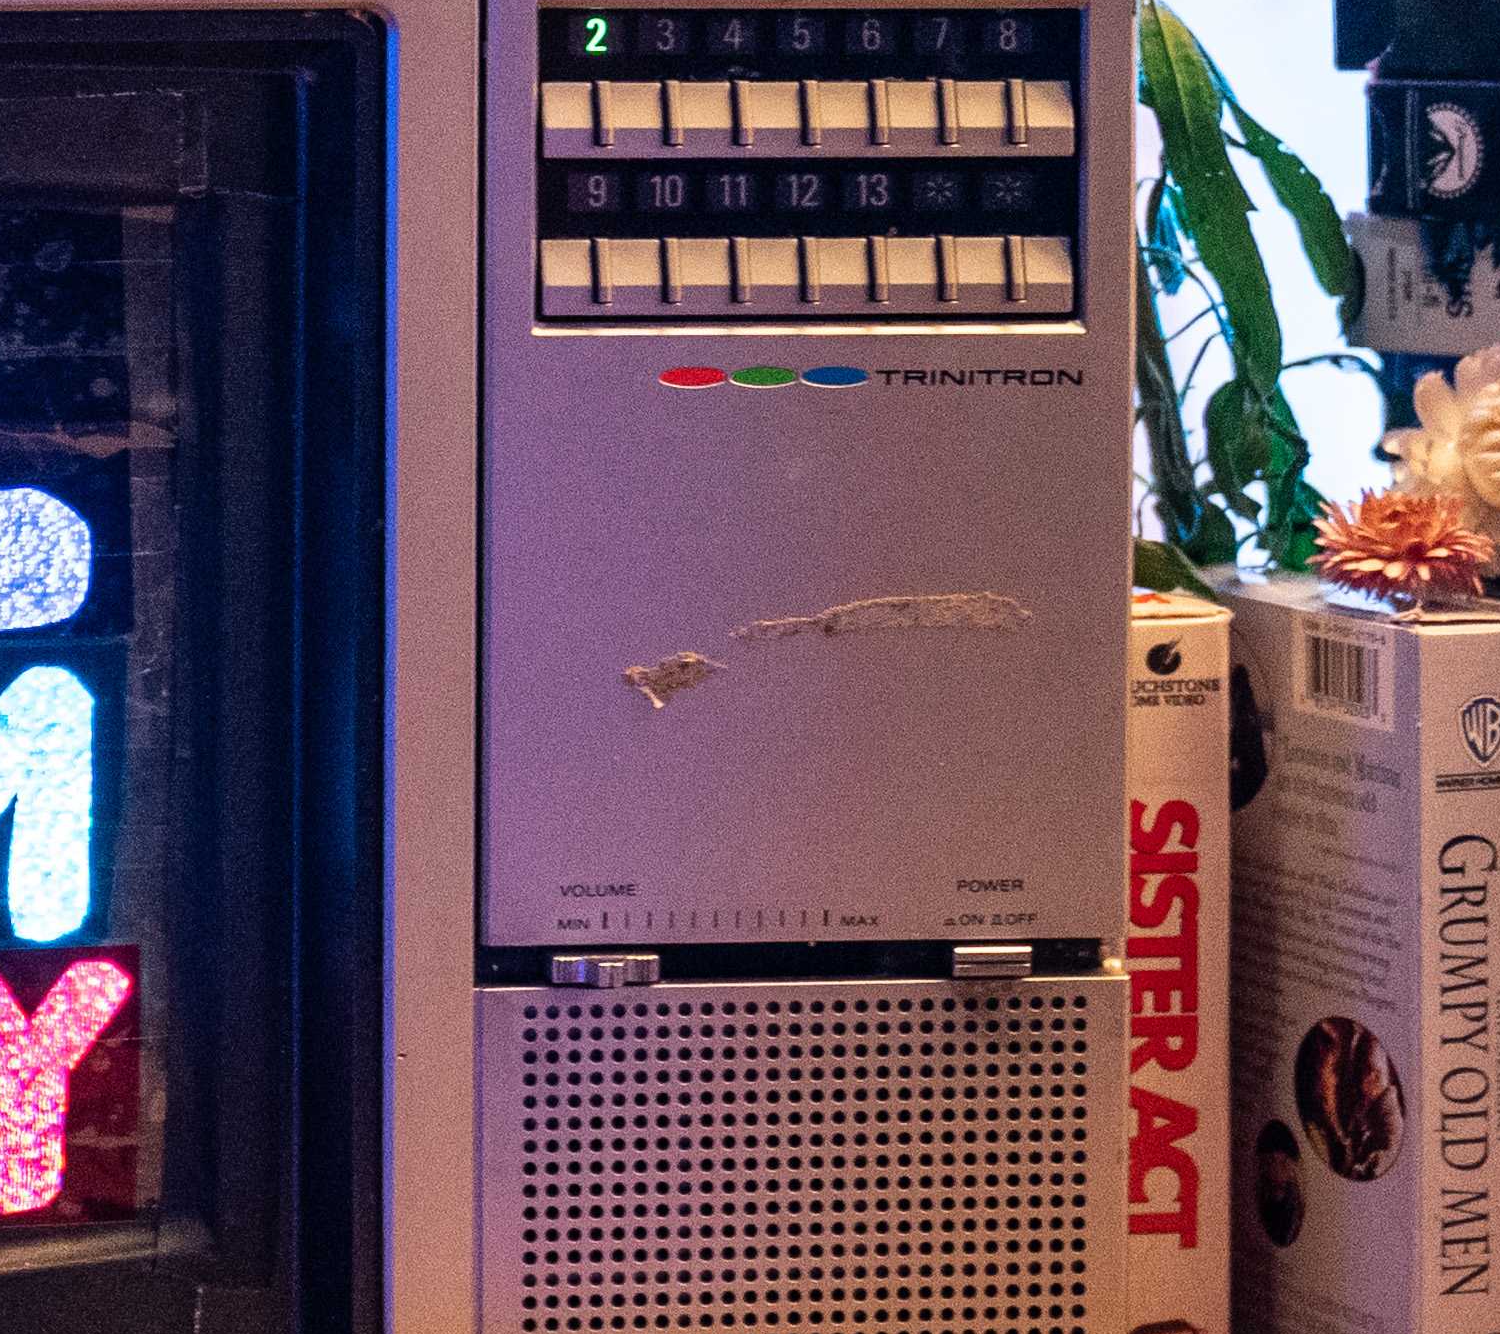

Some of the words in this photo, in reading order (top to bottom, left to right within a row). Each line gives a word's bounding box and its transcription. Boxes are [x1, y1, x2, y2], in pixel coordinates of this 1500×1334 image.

[584, 17, 608, 53] 2
[657, 20, 675, 51] 3
[722, 20, 745, 50] 4
[792, 20, 811, 50] 5
[862, 19, 882, 51] 6
[933, 20, 950, 50] 7
[998, 19, 1018, 51] 8
[587, 176, 608, 208] 9
[650, 175, 683, 208] 10
[720, 176, 748, 207] 11
[789, 175, 821, 207] 12
[856, 174, 890, 207] 13
[874, 368, 1084, 386] TRINITRON
[559, 883, 638, 898] VOLUME
[956, 878, 1025, 893] POWER
[557, 918, 592, 932] MIN
[839, 913, 880, 928] MAX
[957, 913, 985, 926] ON
[1004, 912, 1038, 926] OFF
[1127, 799, 1201, 1070] SISTER
[1436, 833, 1500, 1054] GRUMPY
[1437, 1066, 1492, 1171] OLD
[1127, 1087, 1201, 1250] ACT
[1439, 1188, 1492, 1298] MEN
